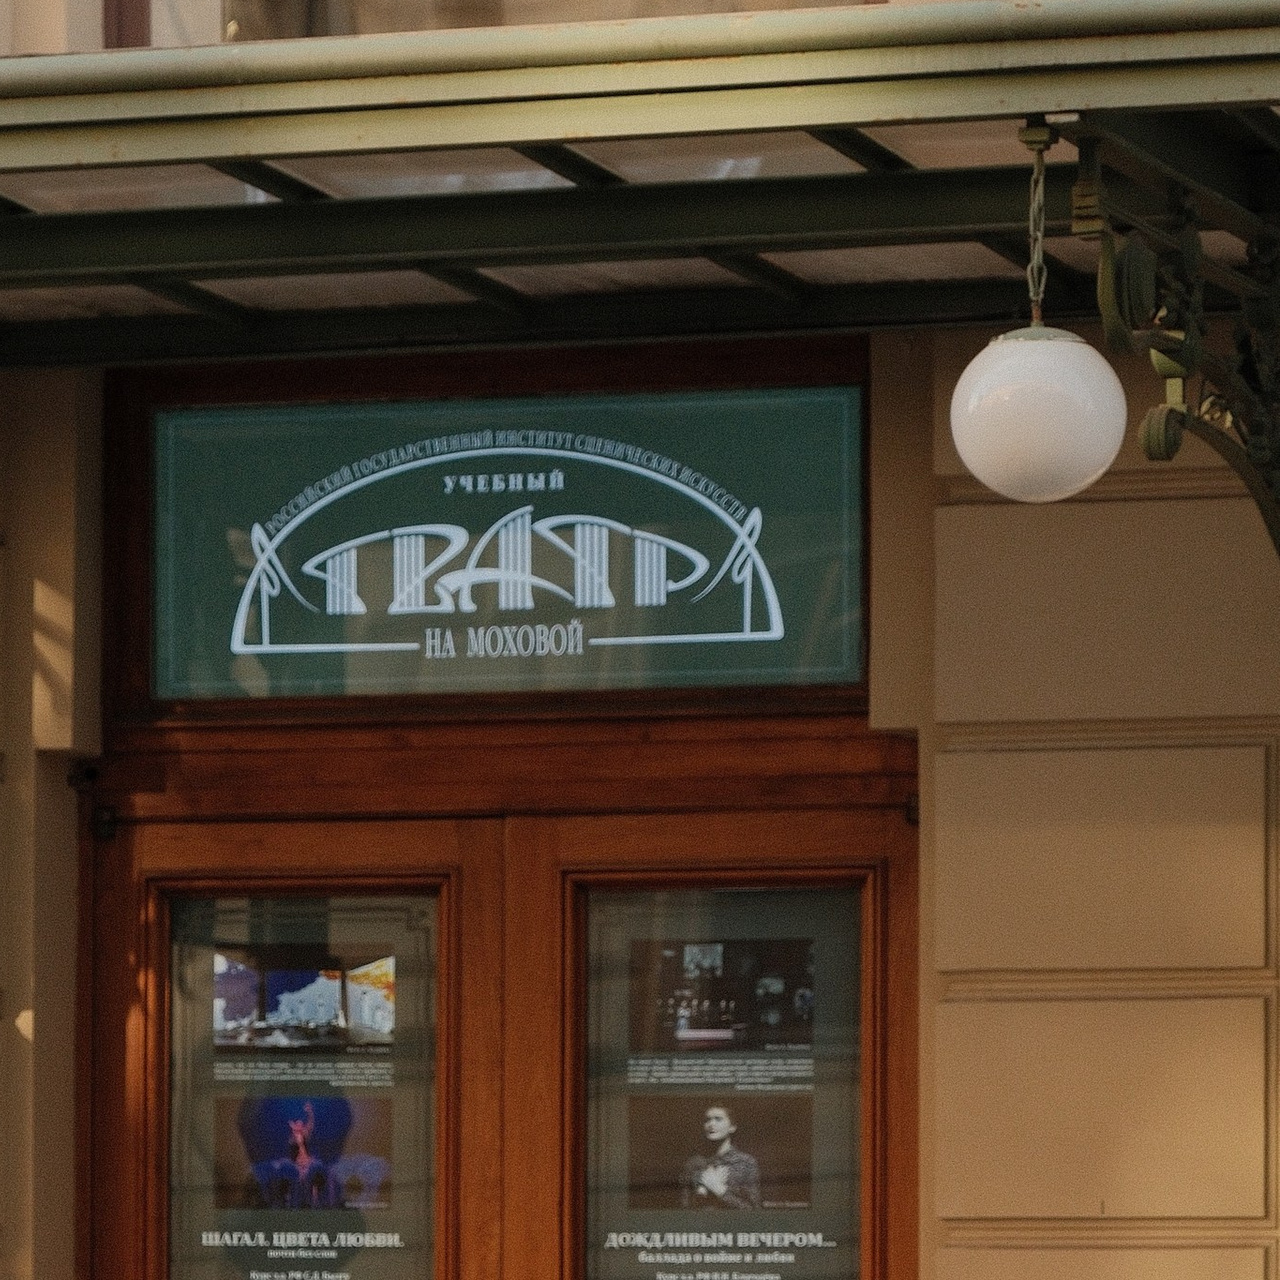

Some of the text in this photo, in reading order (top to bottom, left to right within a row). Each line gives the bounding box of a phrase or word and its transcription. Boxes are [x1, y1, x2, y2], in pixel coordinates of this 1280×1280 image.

[264, 464, 353, 536] РОССИЙСКИЙ
[495, 429, 575, 449] ИНСТИТУТ
[444, 468, 565, 494] УЧЕБНЫЙ
[424, 618, 584, 659] НА МОХОВОЙ
[272, 1231, 330, 1249] ЦВЕТА
[604, 1232, 734, 1250] ДОЖДЛИВЫМ
[638, 1251, 692, 1264] баллада
[693, 1253, 703, 1263] о
[703, 1251, 743, 1264] войне
